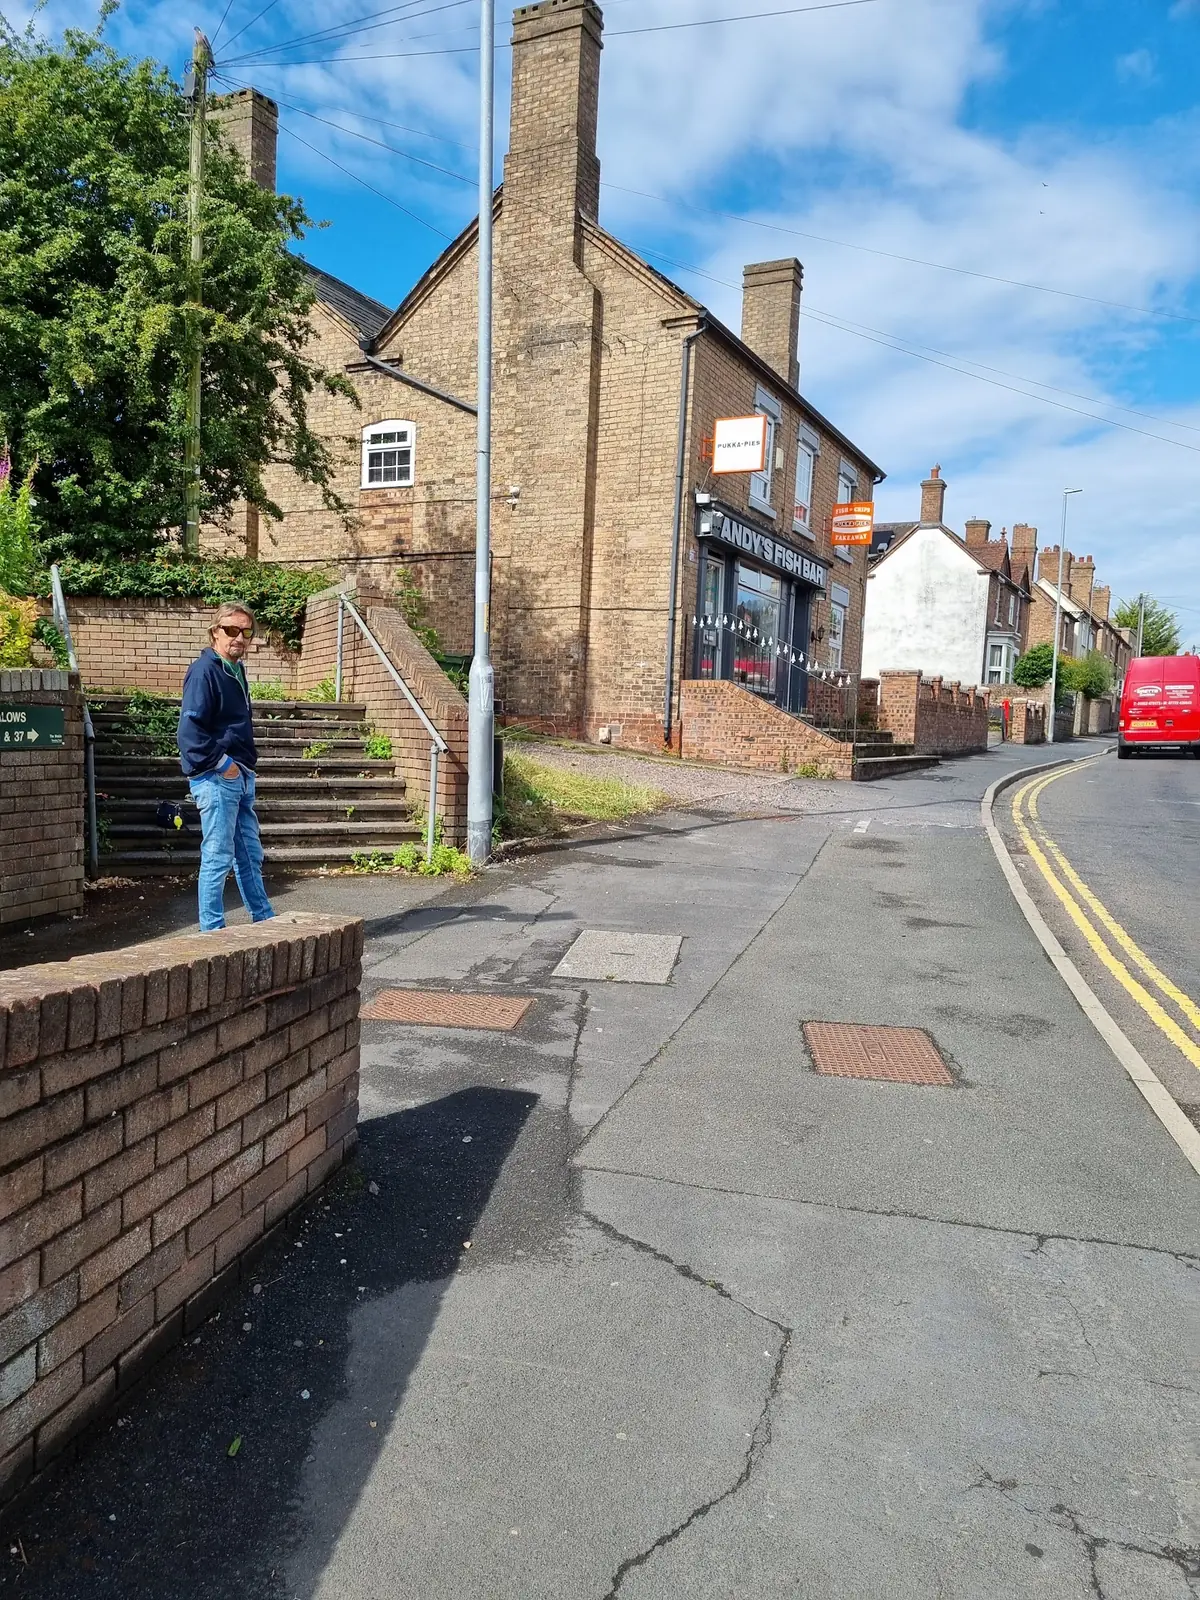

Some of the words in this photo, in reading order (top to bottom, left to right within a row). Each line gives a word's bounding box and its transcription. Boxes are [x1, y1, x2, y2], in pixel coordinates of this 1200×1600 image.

[835, 533, 868, 541] TAKEAWAY
[720, 516, 774, 561] ANDY'S
[774, 543, 801, 576] FISH
[802, 559, 824, 586] BAR
[0, 711, 27, 723] LOWS
[4, 731, 11, 742] &
[14, 731, 25, 742] 37
